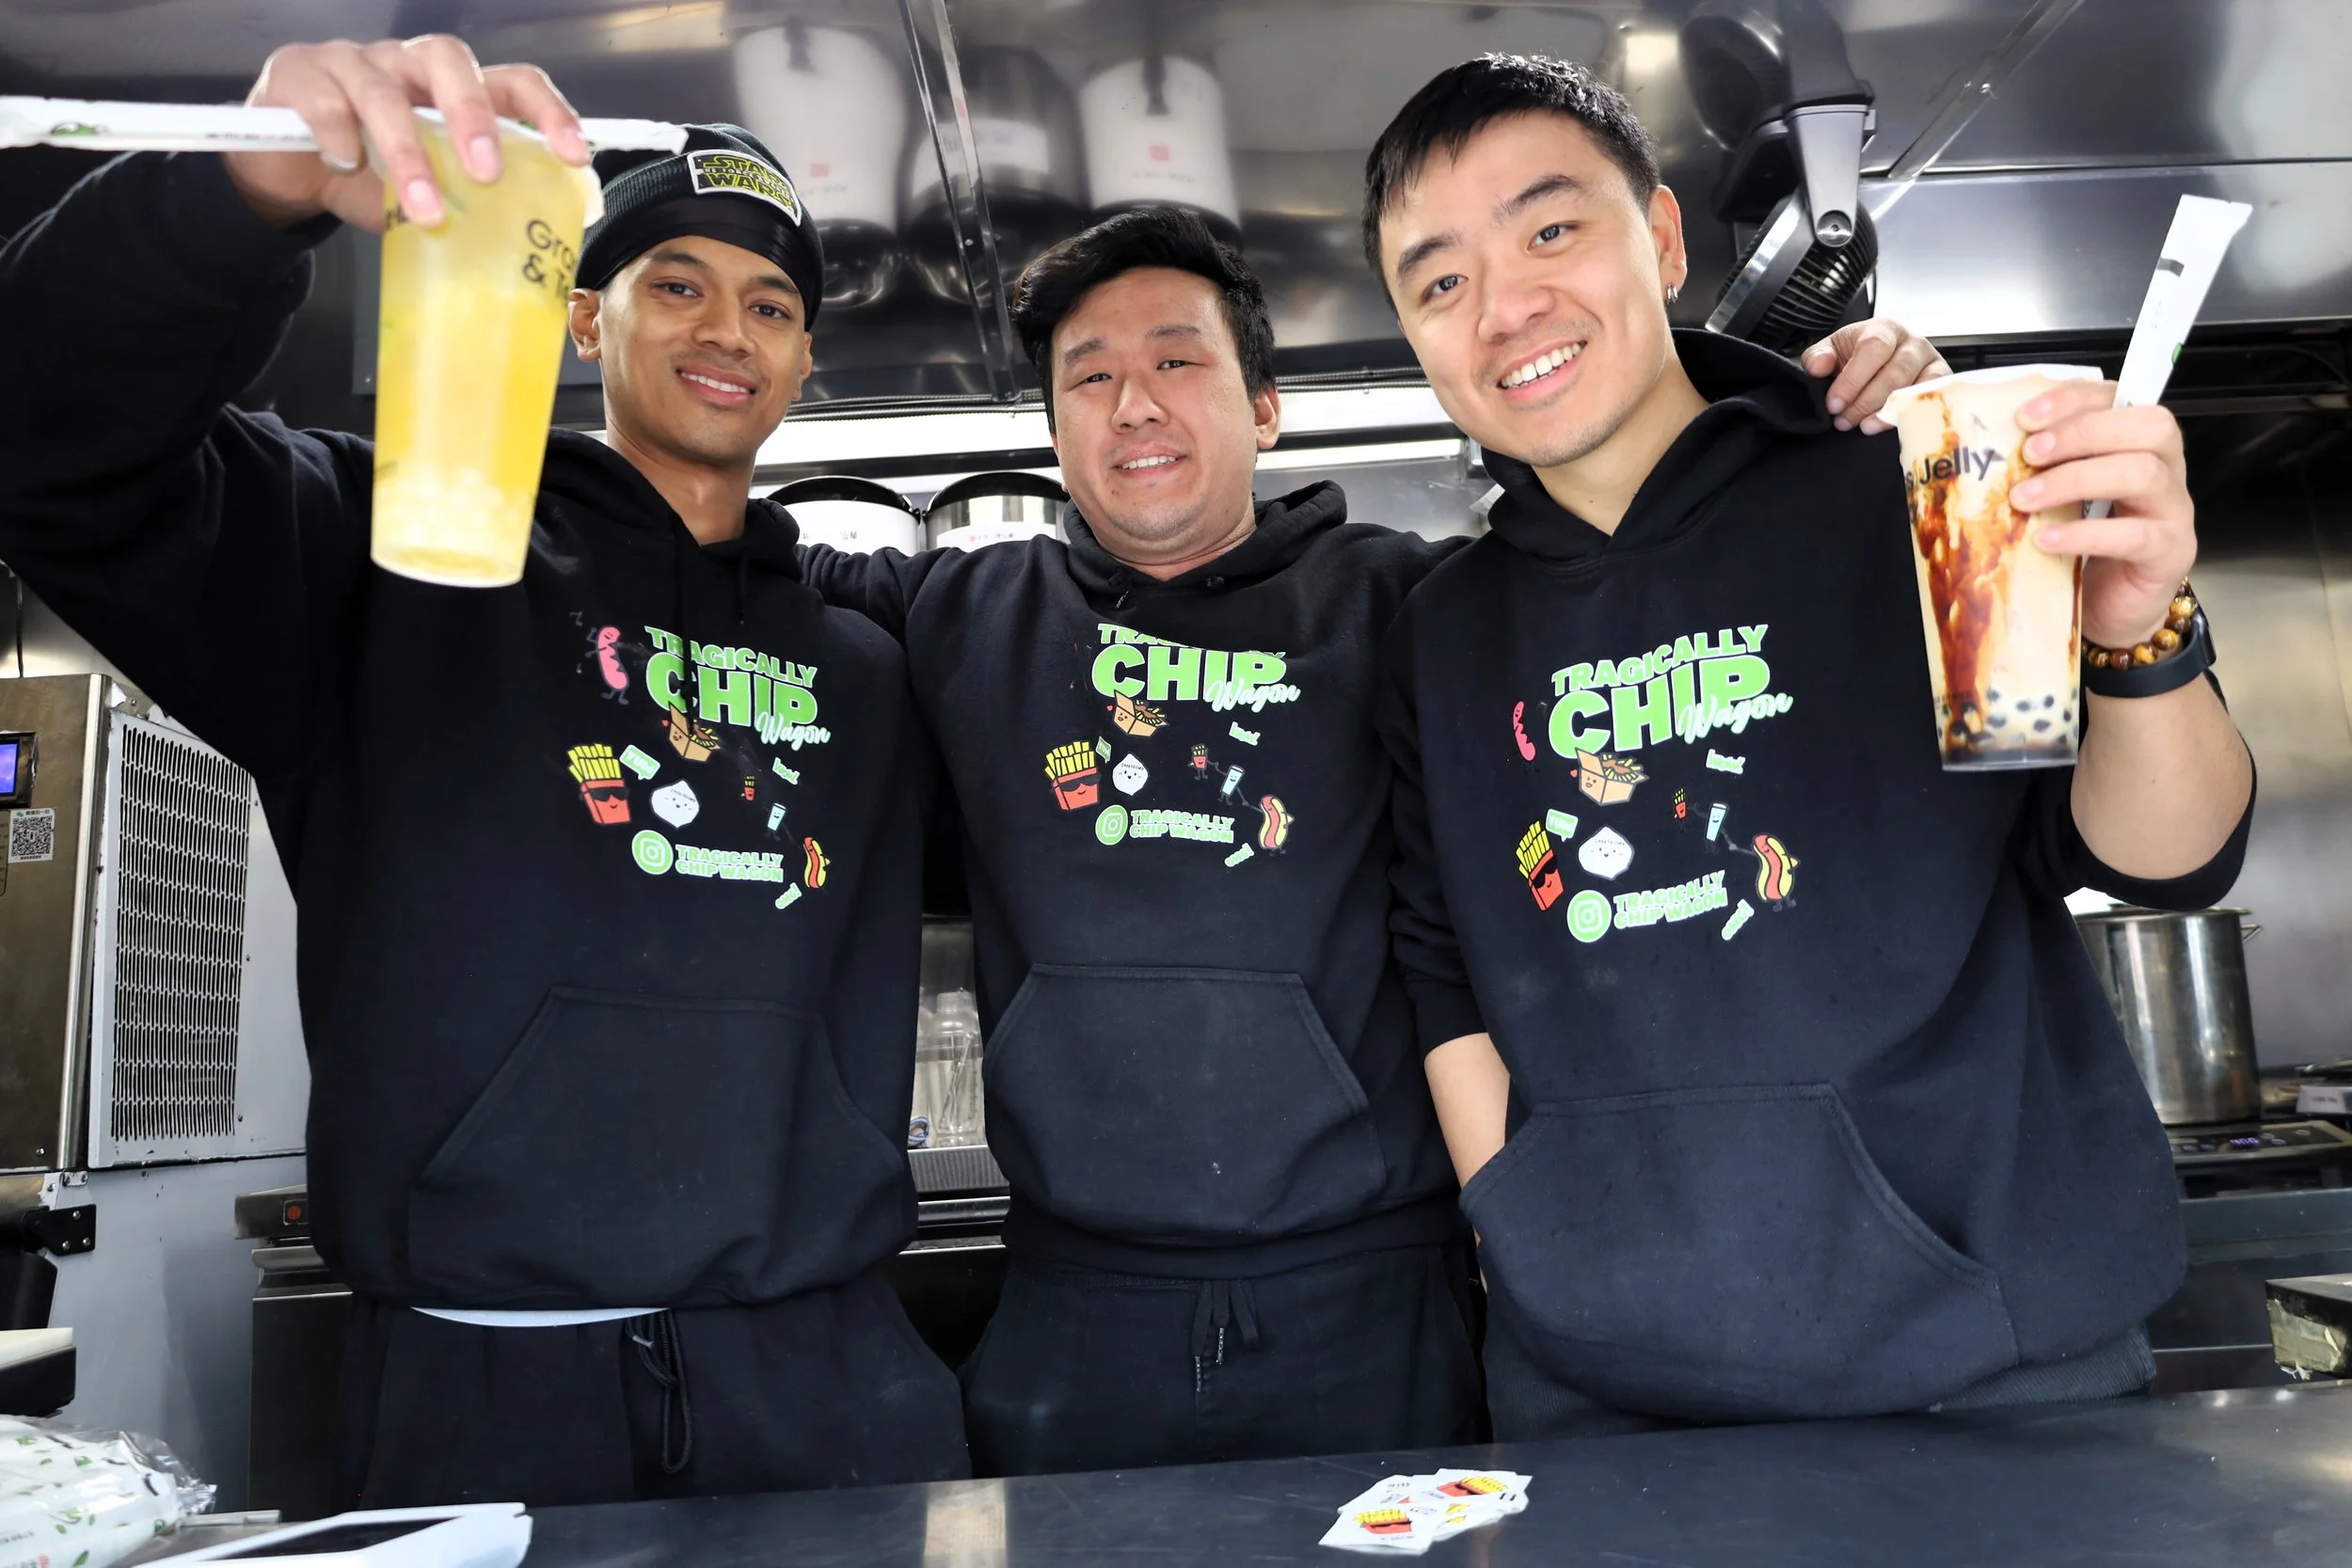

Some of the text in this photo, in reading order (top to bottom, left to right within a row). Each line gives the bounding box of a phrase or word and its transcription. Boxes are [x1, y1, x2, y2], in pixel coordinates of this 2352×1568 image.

[703, 155, 791, 198] STARS
[707, 172, 795, 215] WARS
[522, 252, 548, 288] &
[1919, 446, 1995, 486] Jelly
[644, 625, 818, 689] TRAGICALLY
[1091, 643, 1287, 701] CHIP
[1550, 624, 1769, 697] TRAGICALLY
[645, 652, 818, 727] CHIP
[1204, 678, 1302, 713] Wagon
[1548, 655, 1772, 760] CHIP
[754, 711, 832, 752] Wagon
[1676, 692, 1794, 745] Wagon
[1129, 822, 1234, 844] CHIP WAGON
[1130, 809, 1235, 831] TRAGICALLY
[675, 845, 784, 867] TRAGICALLY
[675, 859, 784, 883] CHIP WAGON
[1613, 869, 1725, 913] TRAGICALLY
[1613, 887, 1728, 929] CHIP WAGON
